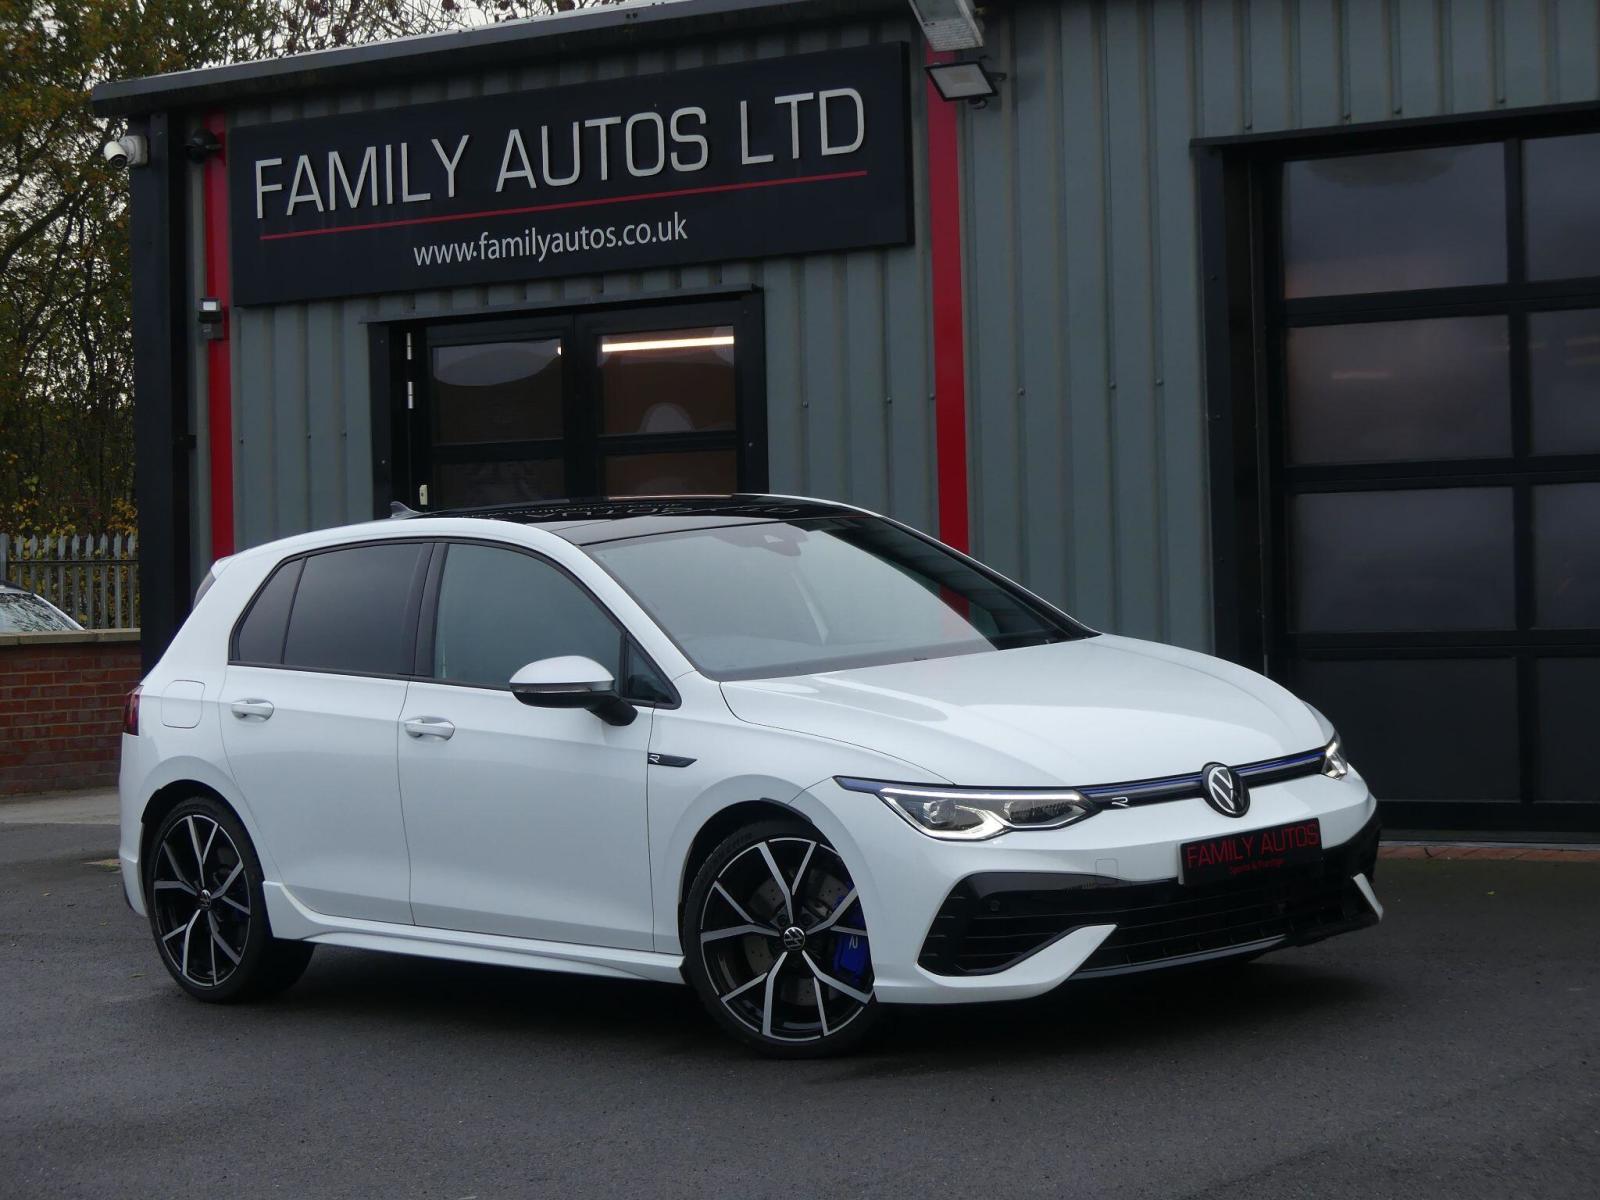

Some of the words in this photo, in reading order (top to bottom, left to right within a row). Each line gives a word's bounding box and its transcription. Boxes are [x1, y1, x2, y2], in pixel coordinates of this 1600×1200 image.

[254, 134, 470, 220] FAMILY
[495, 106, 708, 194] AUTOS
[740, 87, 866, 166] LTD
[412, 211, 689, 266] www.familyautos.co.uk
[1187, 836, 1255, 869] FAMILY
[1261, 824, 1319, 855] AUTOS
